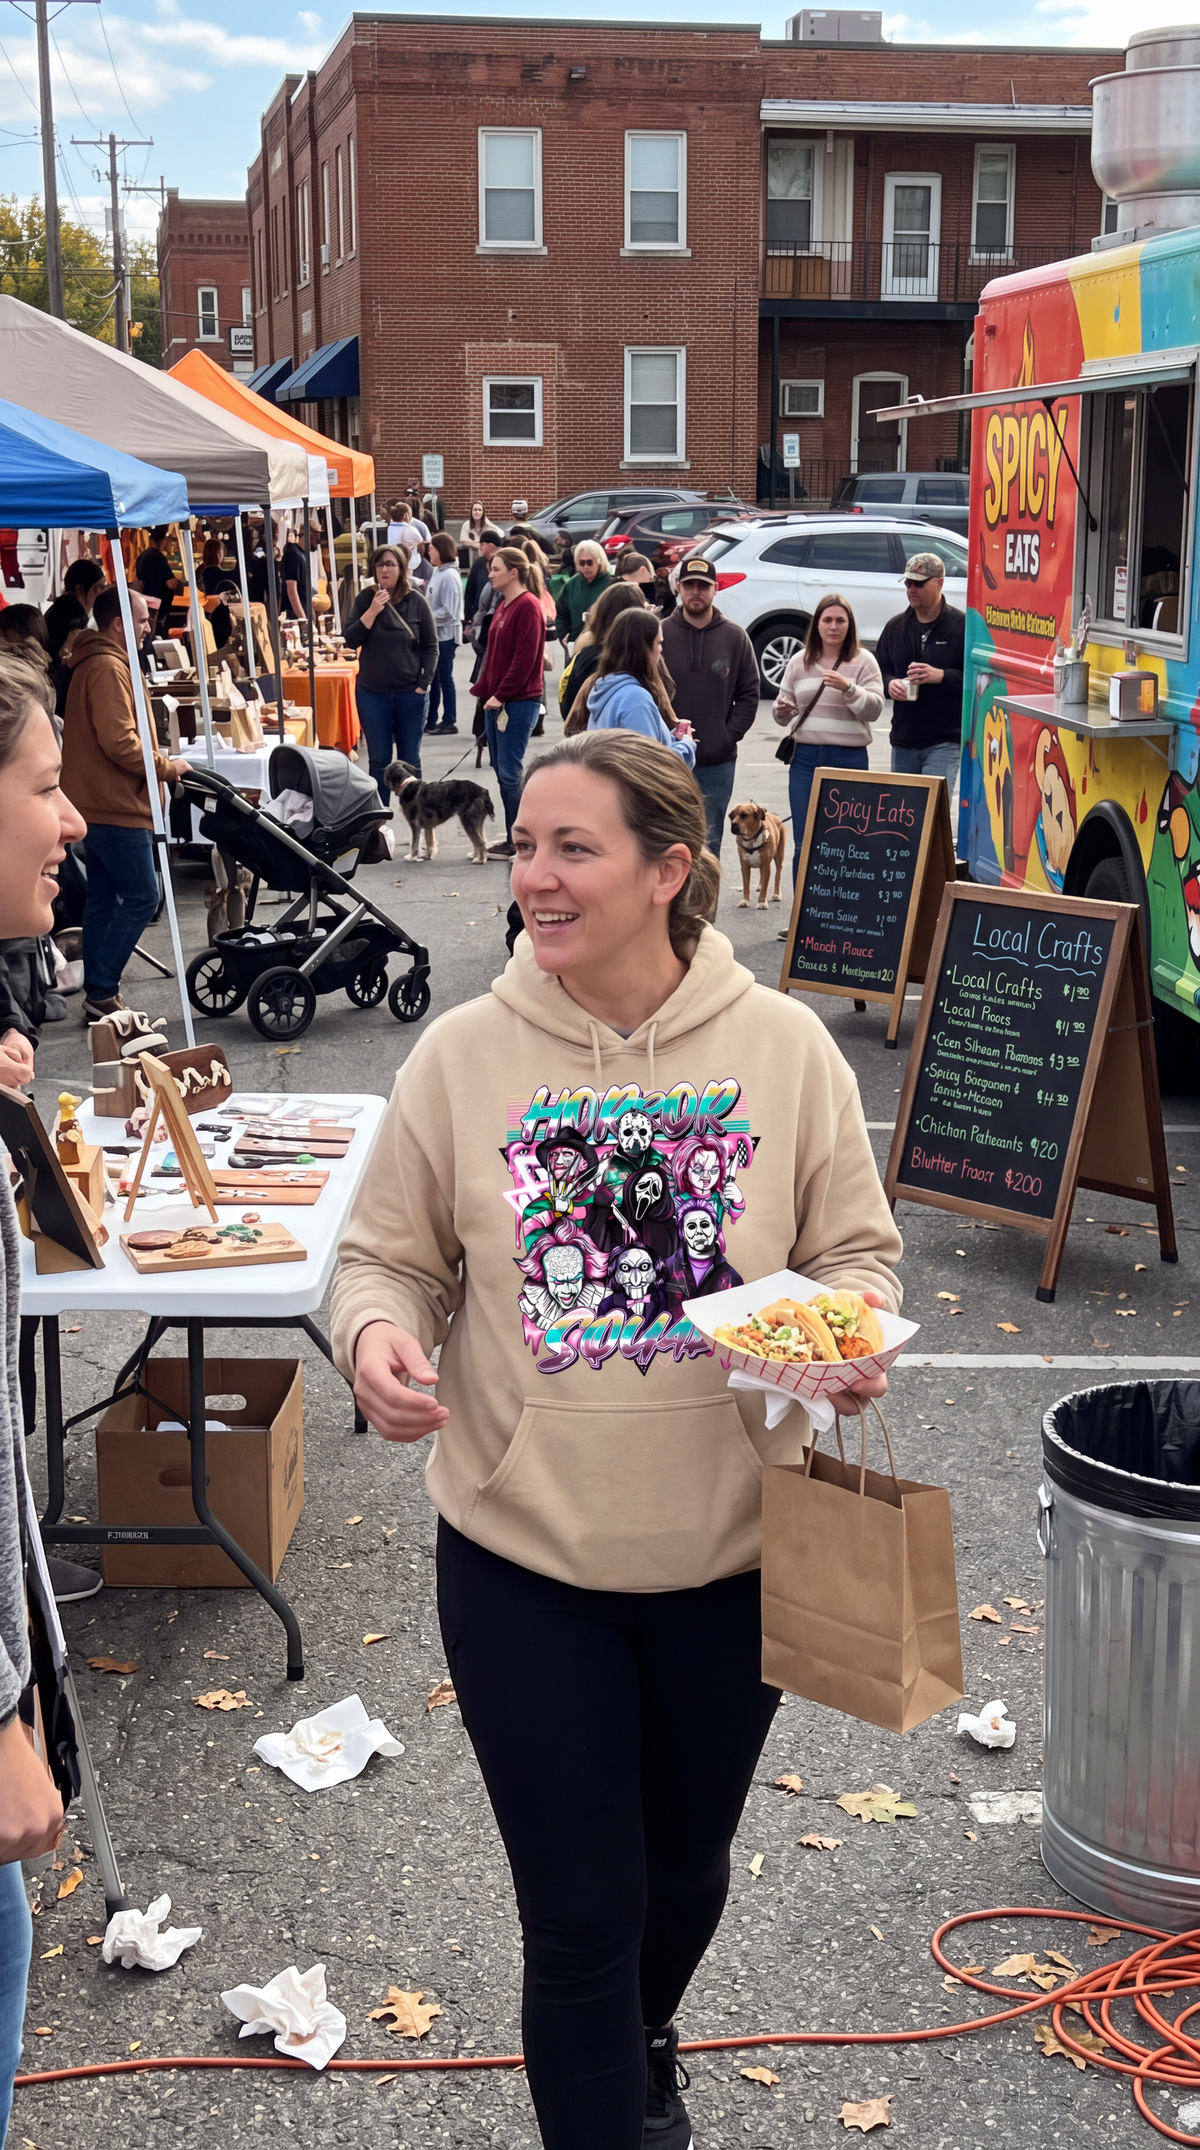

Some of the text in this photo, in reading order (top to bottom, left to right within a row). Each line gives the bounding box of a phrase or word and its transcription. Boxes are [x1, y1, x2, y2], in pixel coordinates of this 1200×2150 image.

[984, 405, 1068, 529] SPICY
[1004, 531, 1041, 580] EATS
[824, 788, 915, 833] Spicy Eats
[973, 913, 1103, 965] Local Crafts
[951, 964, 991, 990] Local
[995, 972, 1043, 1000] Crafts
[943, 998, 975, 1019] Local
[1004, 1168, 1043, 1197] $200
